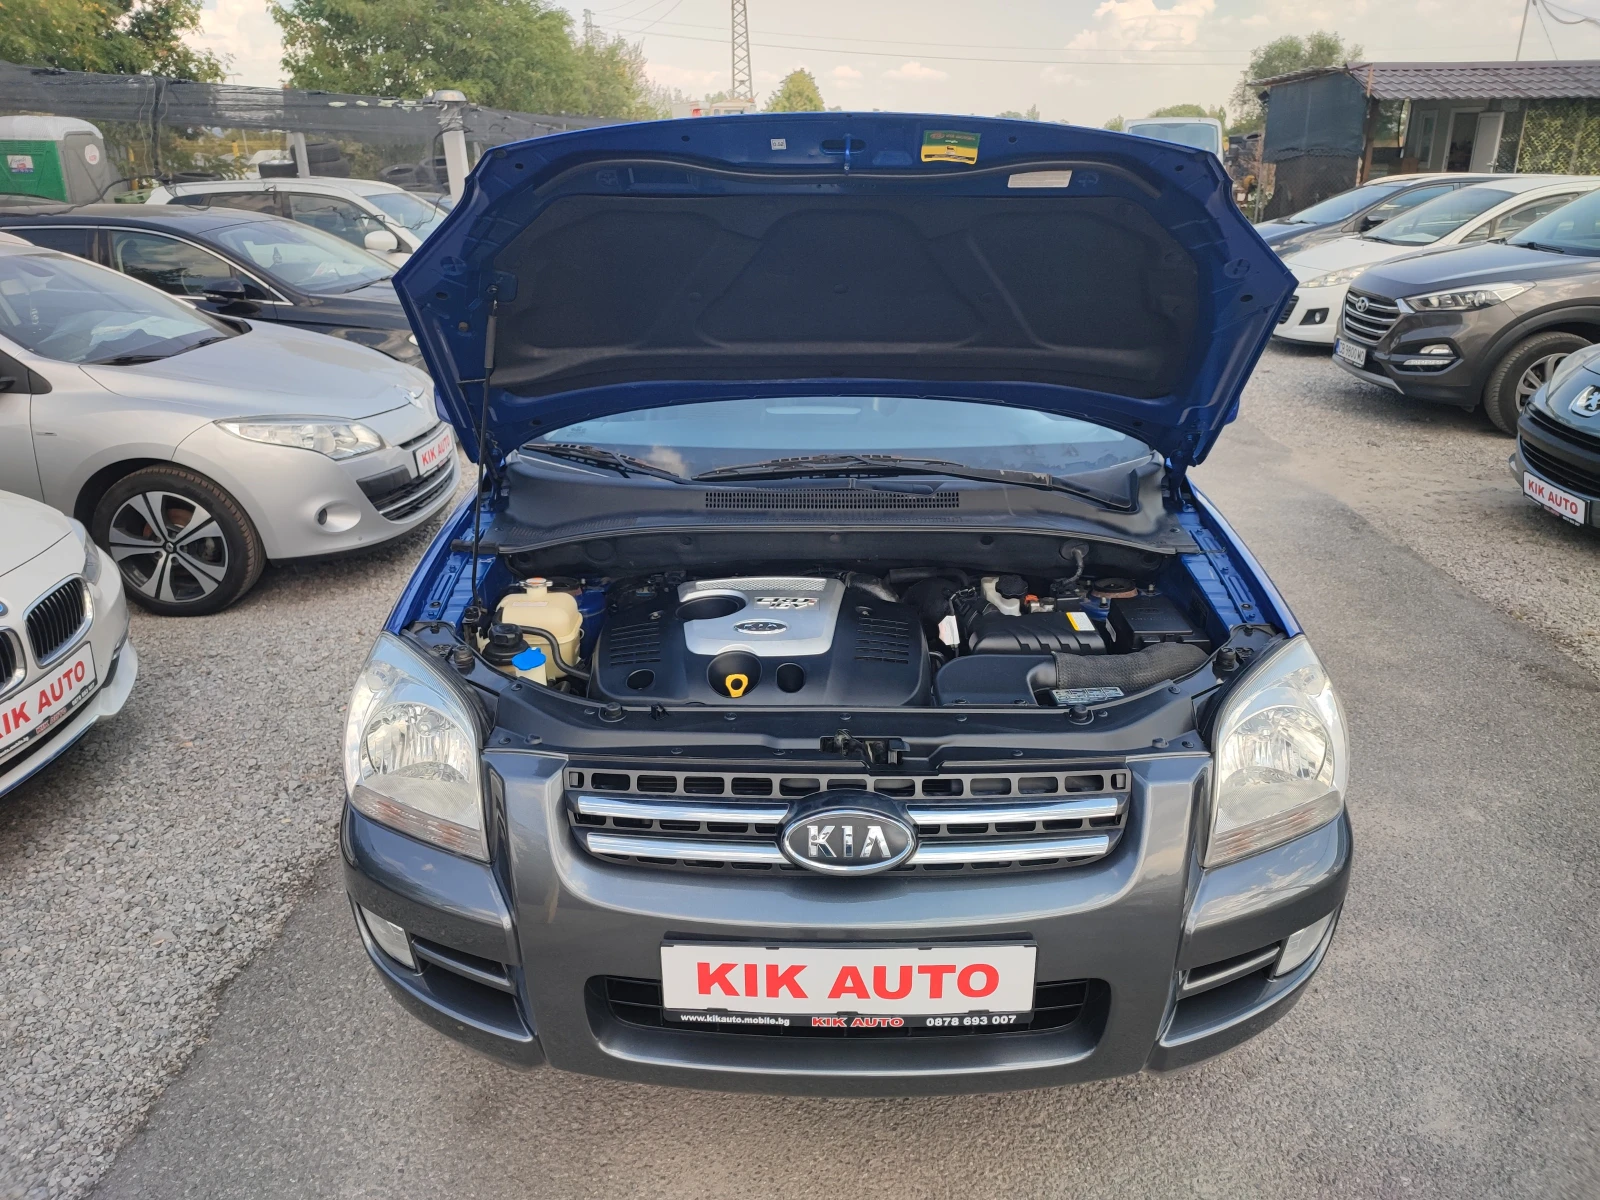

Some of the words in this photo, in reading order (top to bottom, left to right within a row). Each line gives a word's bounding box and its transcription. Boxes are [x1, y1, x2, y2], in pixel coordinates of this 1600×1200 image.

[421, 446, 437, 466] KIK
[438, 435, 450, 456] AUTO
[1528, 479, 1545, 498] KIK
[1547, 490, 1578, 514] AUTO
[0, 701, 31, 739] IK
[38, 660, 85, 714] AUTO
[806, 825, 892, 858] KIA
[697, 962, 809, 999] KIK
[827, 963, 1000, 1000] AUTO
[680, 1013, 790, 1027] www.kikauto.mobile.bg
[811, 1017, 847, 1027] KIK
[850, 1017, 904, 1027] AUTO
[926, 1017, 959, 1026] 0878
[963, 1016, 988, 1025] 693
[991, 1015, 1017, 1025] 007
